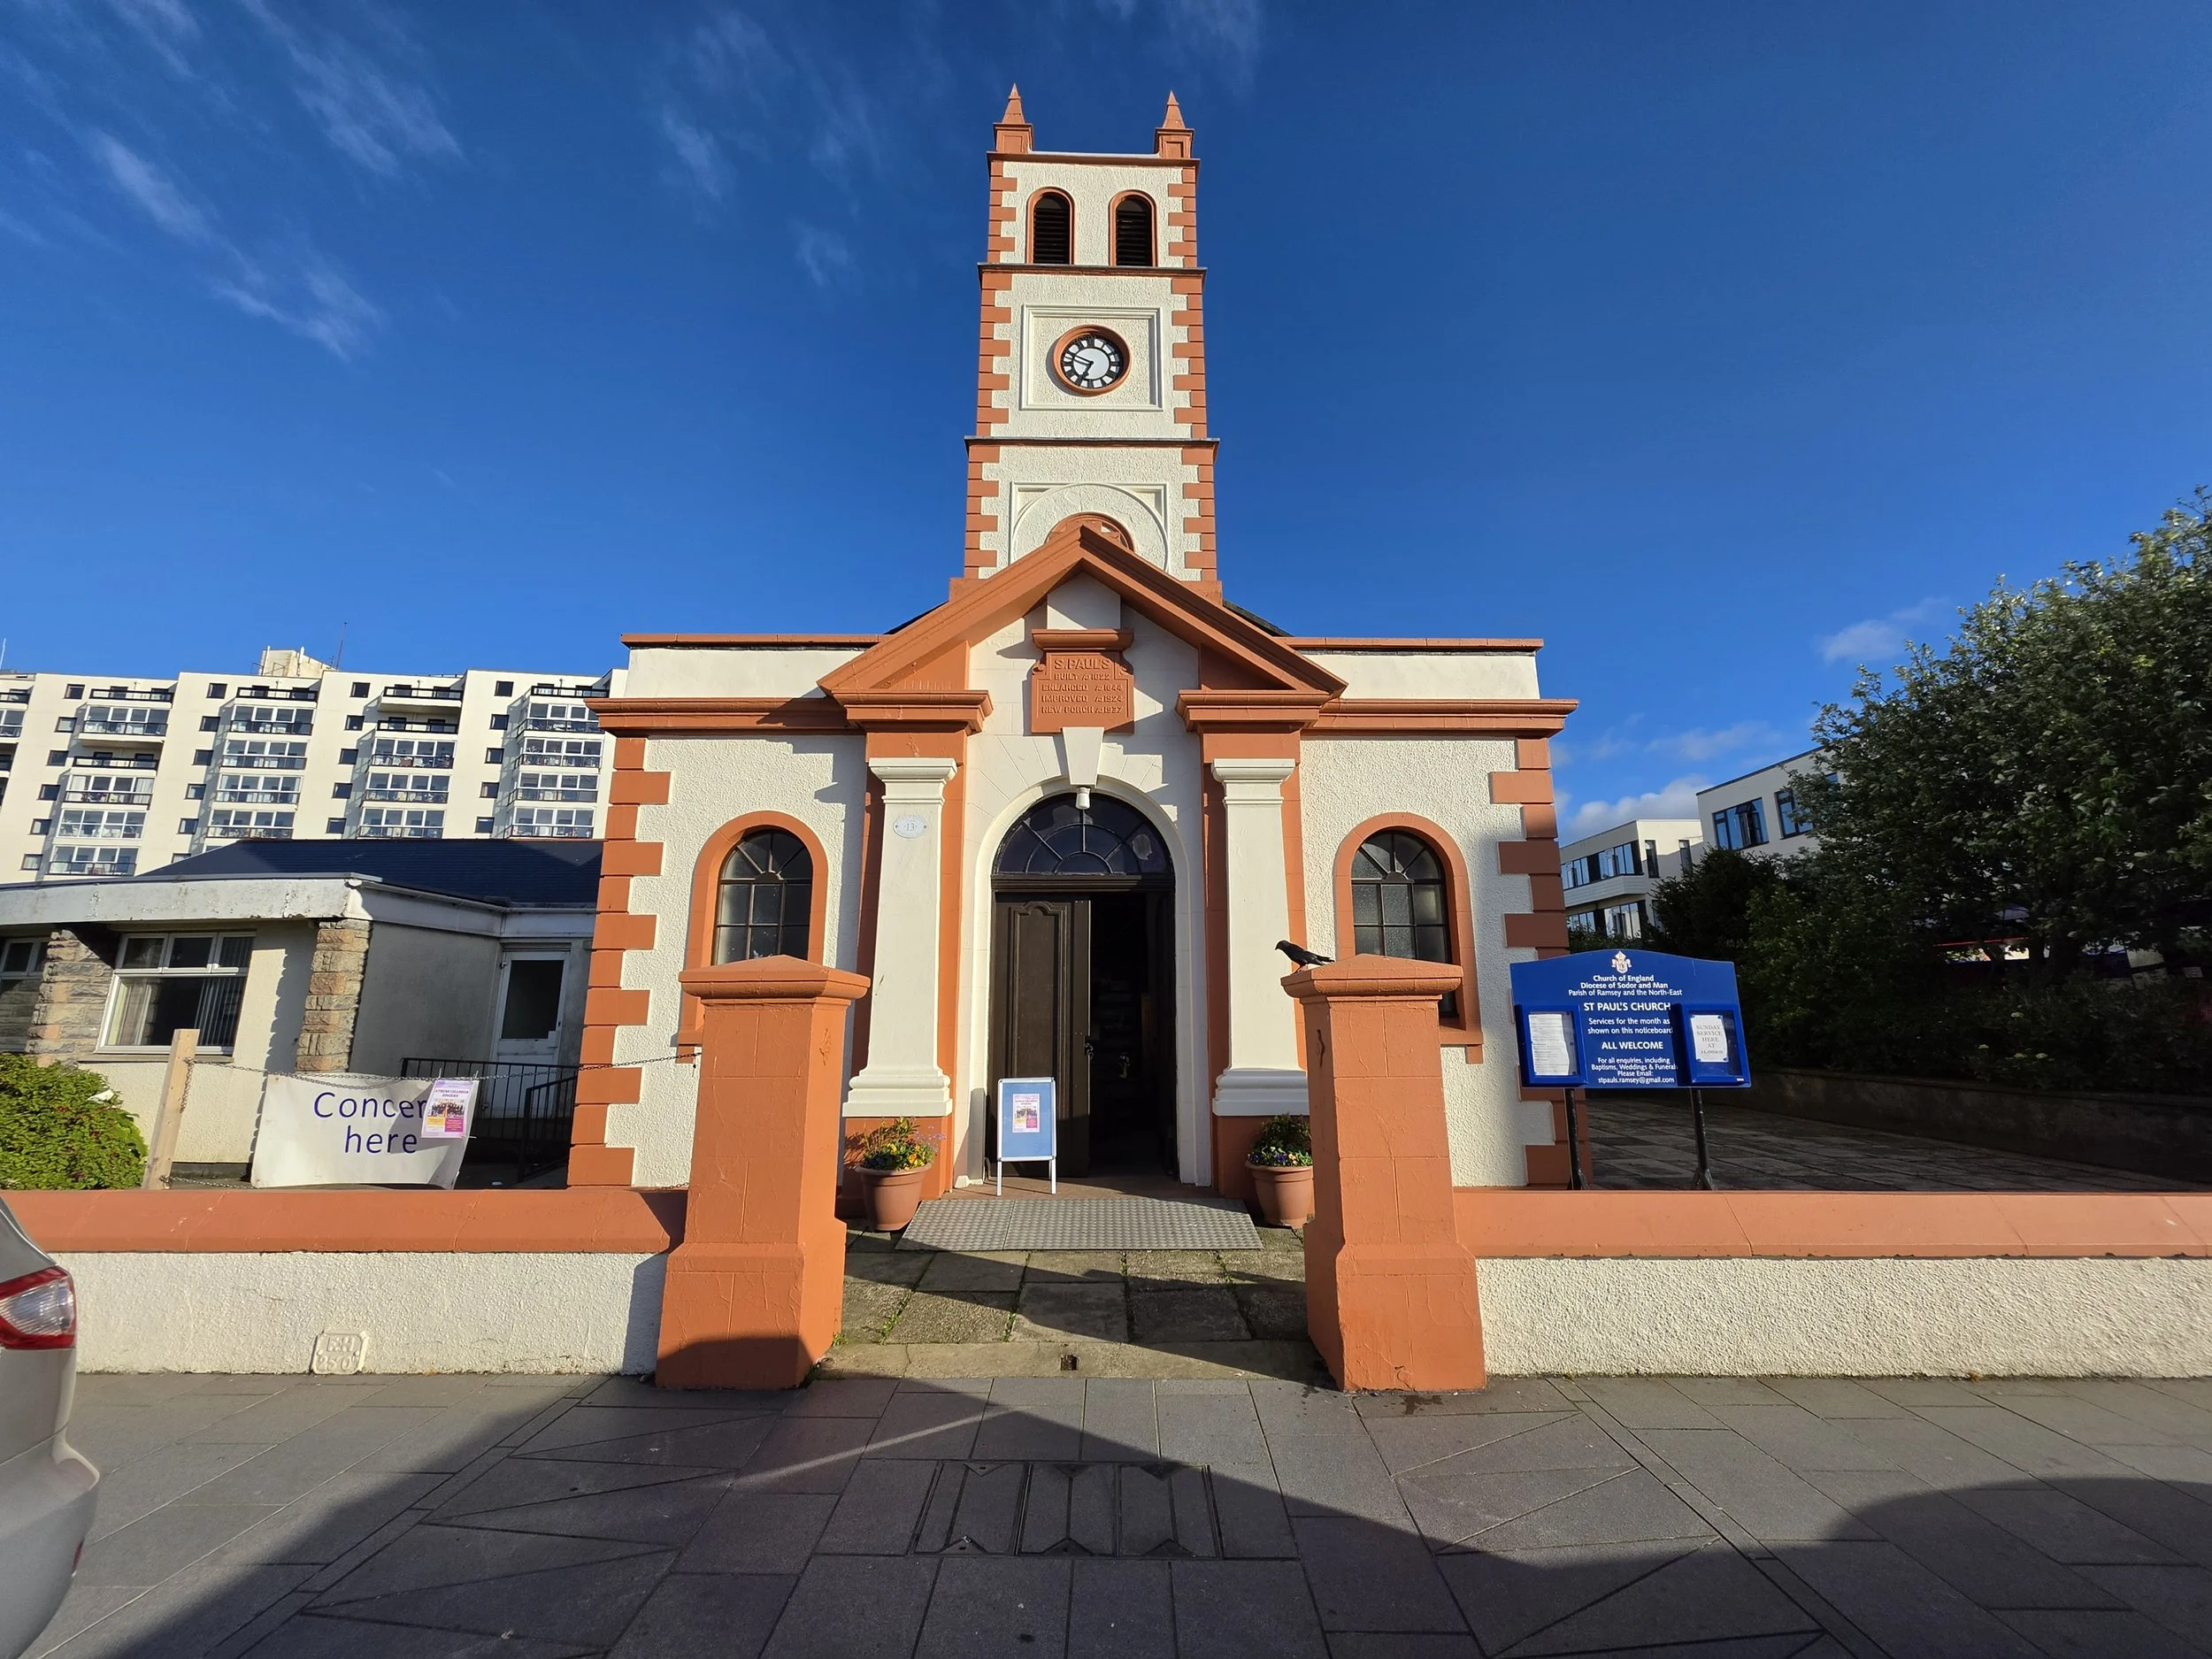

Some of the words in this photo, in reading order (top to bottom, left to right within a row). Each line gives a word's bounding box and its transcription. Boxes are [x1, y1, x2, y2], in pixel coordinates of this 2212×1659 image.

[1584, 1002, 1595, 1011] ST
[1597, 1002, 1628, 1011] PAUL'S
[1631, 1002, 1671, 1011] CHURCH
[314, 1091, 426, 1118] Concer
[344, 1125, 418, 1154] here
